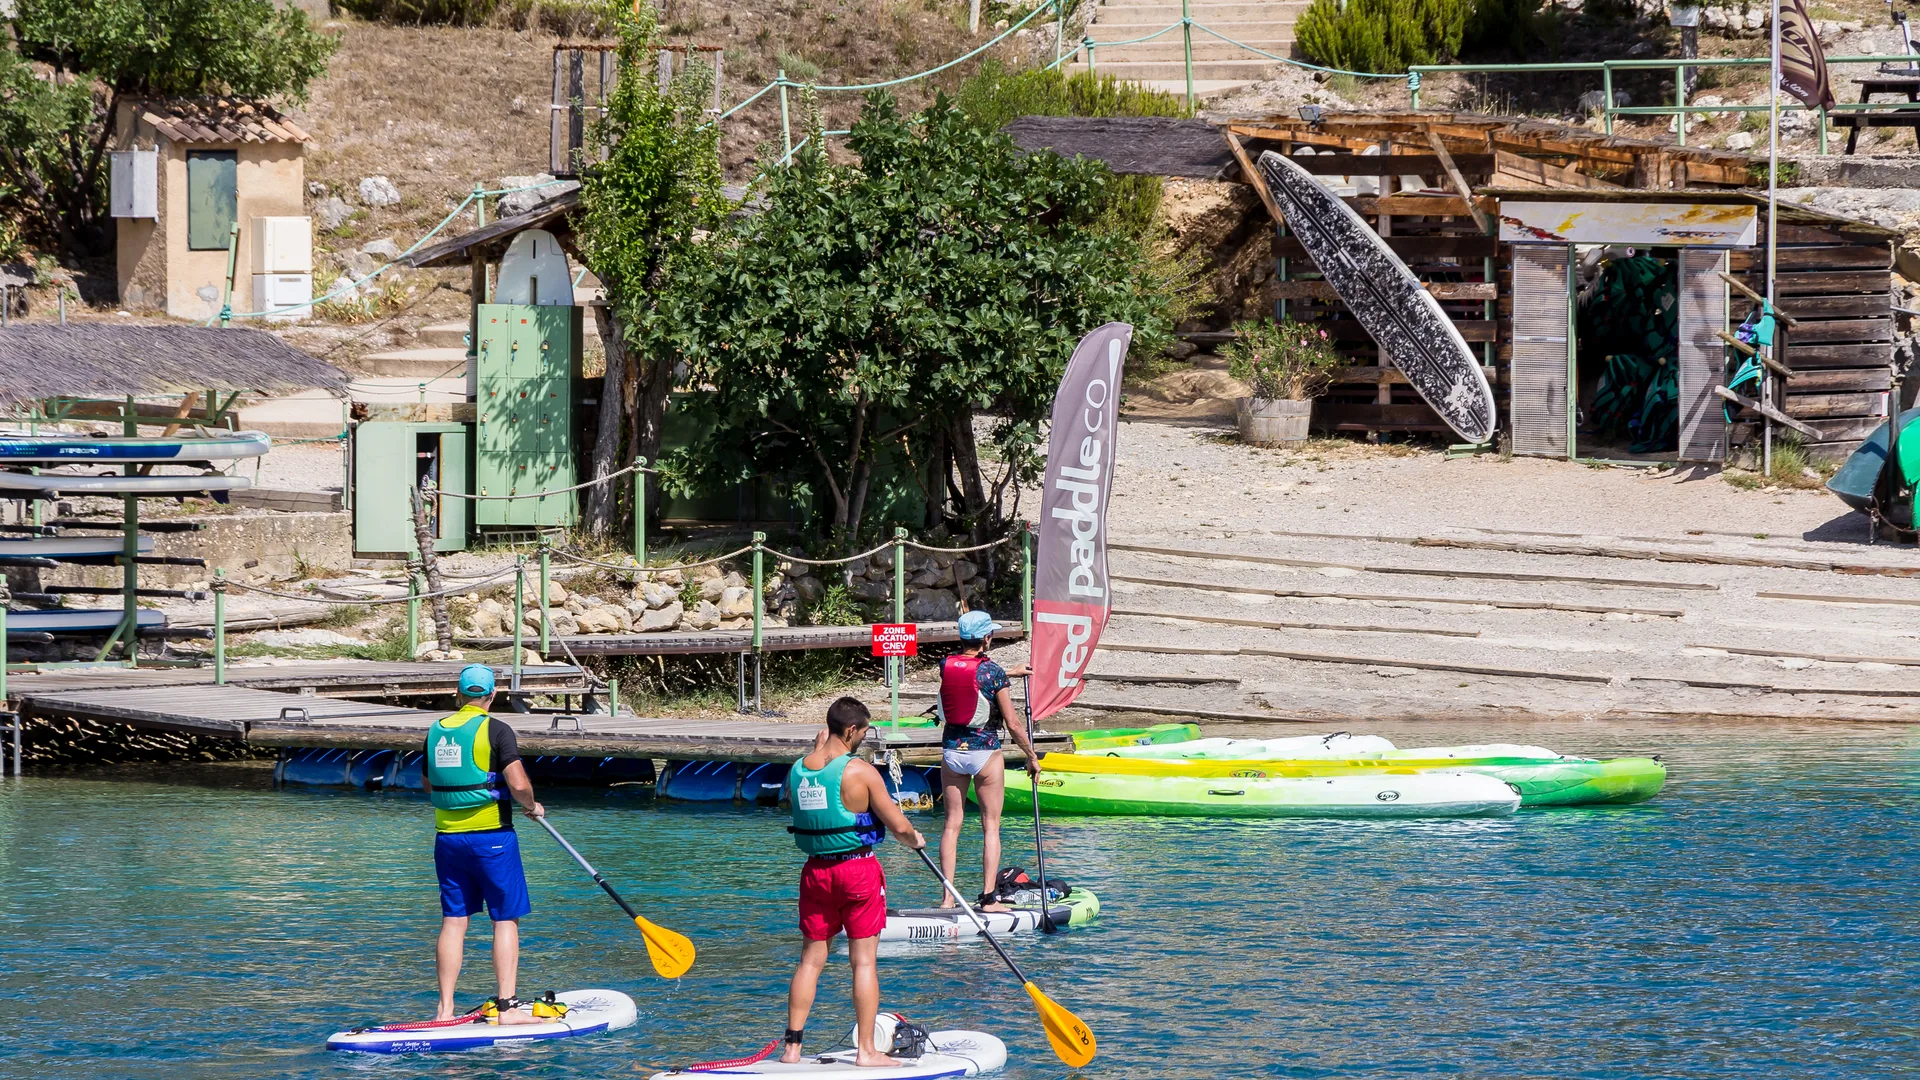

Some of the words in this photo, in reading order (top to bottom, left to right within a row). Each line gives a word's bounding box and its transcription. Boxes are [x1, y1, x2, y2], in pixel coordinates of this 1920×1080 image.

[883, 626, 906, 634] ZONE
[882, 642, 907, 650] CNEV
[1036, 611, 1093, 689] red
[436, 748, 459, 757] CNEV
[800, 790, 823, 799] CNEV
[908, 925, 946, 939] THRIVE
